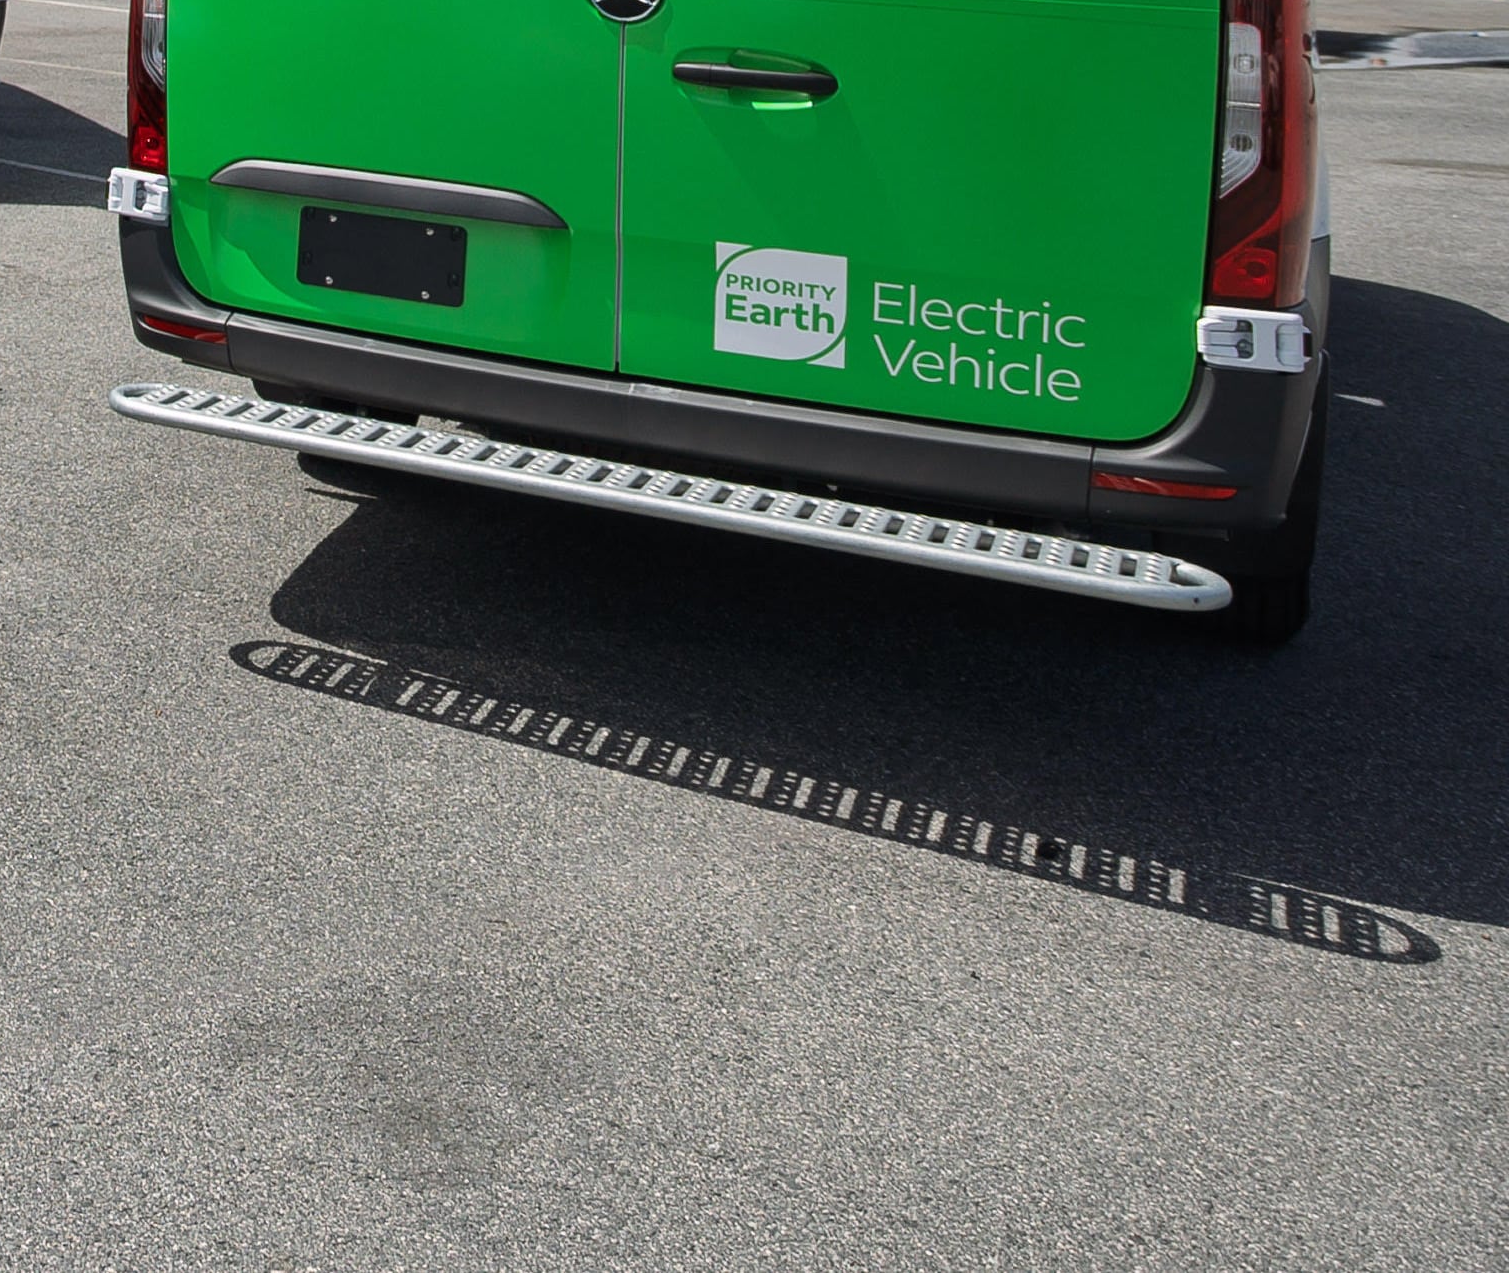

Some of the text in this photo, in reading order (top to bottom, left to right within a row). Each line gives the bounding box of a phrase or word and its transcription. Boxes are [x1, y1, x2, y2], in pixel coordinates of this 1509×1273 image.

[724, 293, 836, 335] Earth
[725, 273, 837, 303] PRIORITY
[873, 281, 1086, 348] Electric
[874, 334, 1082, 402] Vehicle
